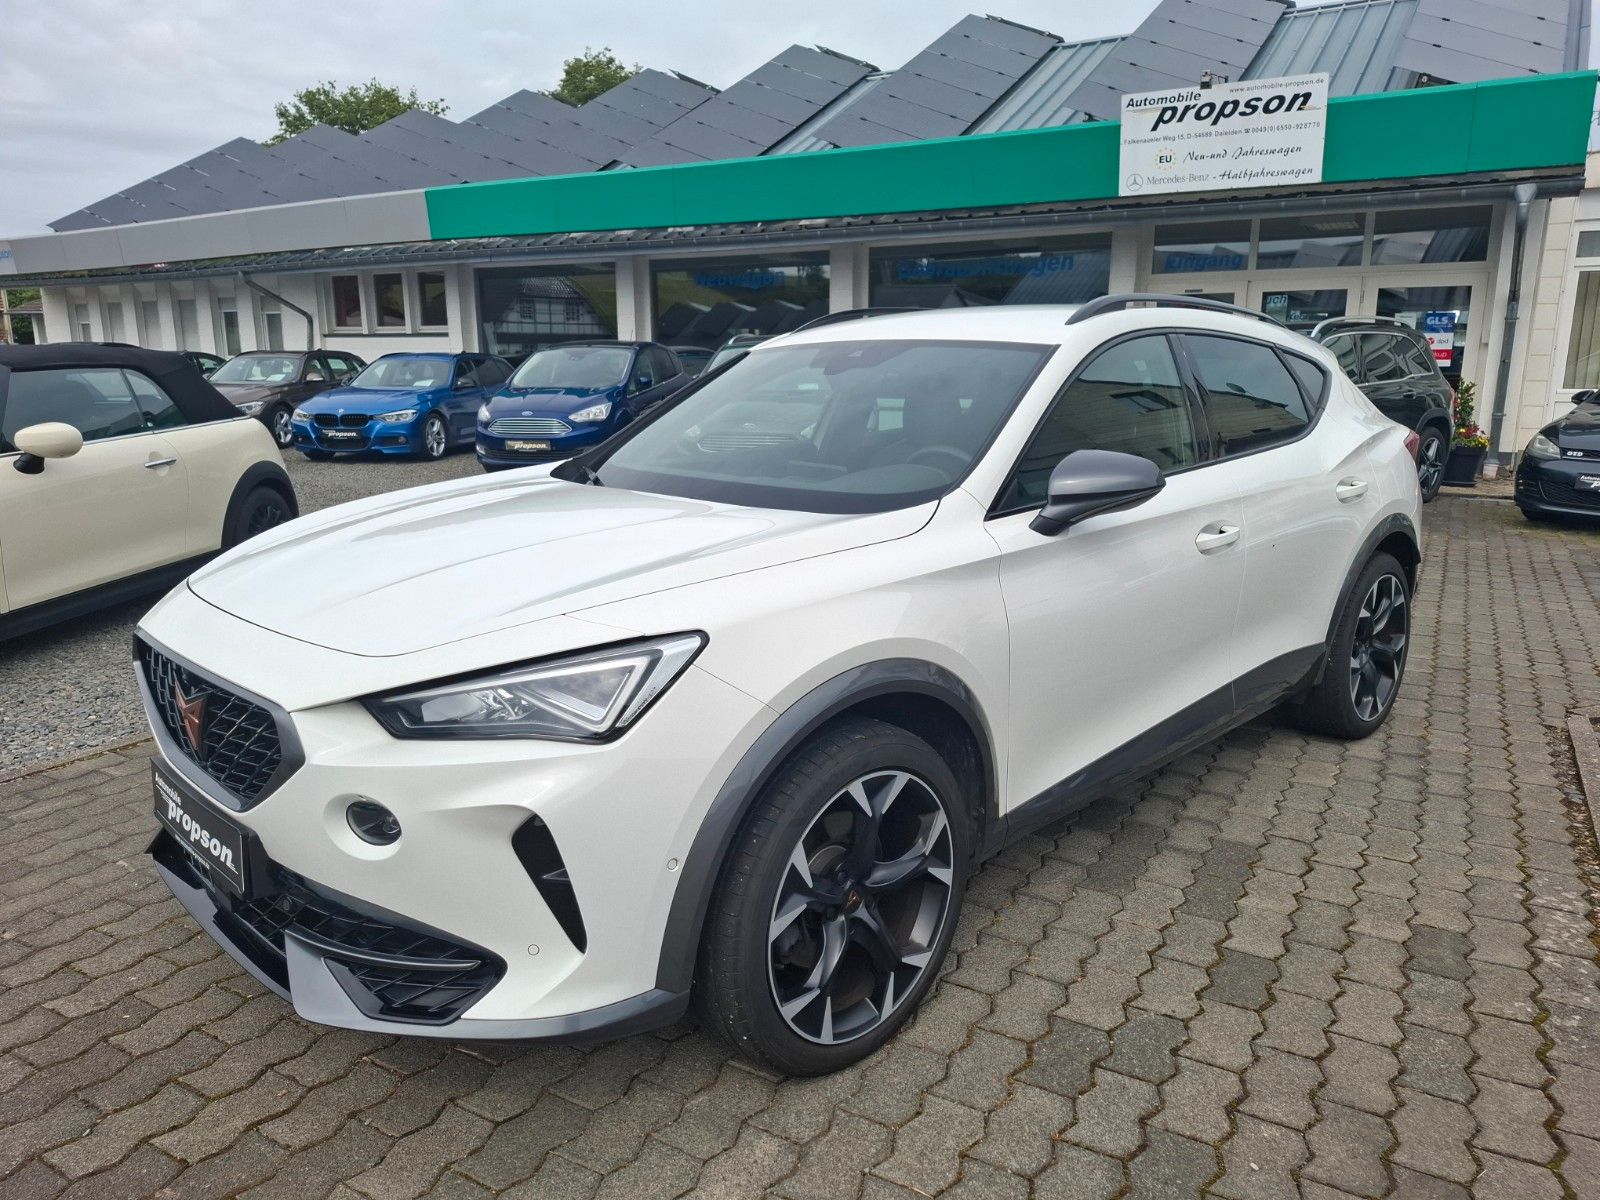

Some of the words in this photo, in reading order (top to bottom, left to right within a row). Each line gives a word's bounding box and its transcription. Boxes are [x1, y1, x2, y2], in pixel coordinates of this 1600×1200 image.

[1229, 78, 1324, 93] www.automobile-propson.de
[1126, 91, 1201, 109] Automobile
[1150, 91, 1313, 132] propson
[1158, 154, 1173, 164] EU
[1232, 145, 1303, 160] Jahreswagen
[1146, 173, 1210, 186] Mercedes-Benz
[1165, 254, 1244, 273] Eingang
[1426, 316, 1449, 325] GLS
[168, 801, 234, 869] propson
